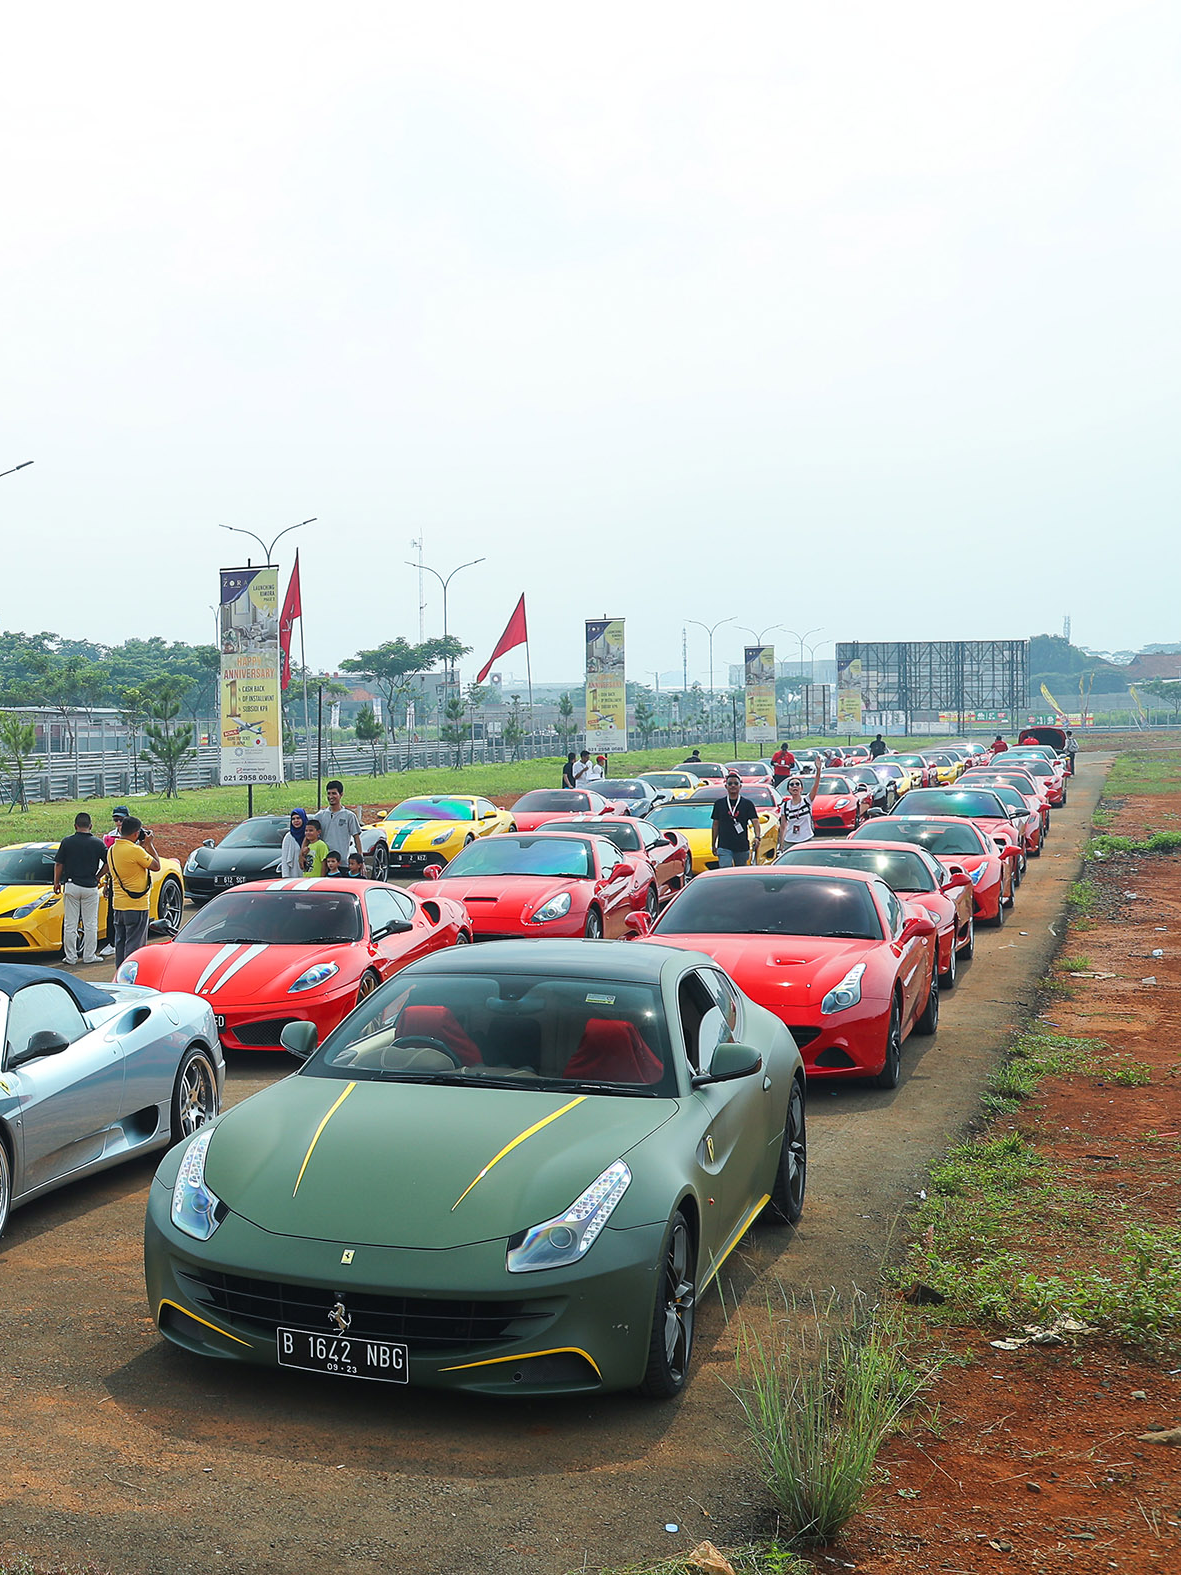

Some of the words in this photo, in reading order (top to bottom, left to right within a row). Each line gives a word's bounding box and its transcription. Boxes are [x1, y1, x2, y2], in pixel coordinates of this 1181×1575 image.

[237, 657, 261, 667] HAPPY
[224, 668, 275, 679] ANNIVERSARY
[283, 1332, 294, 1354] B
[308, 1336, 351, 1363] 1642
[367, 1344, 403, 1369] NBG
